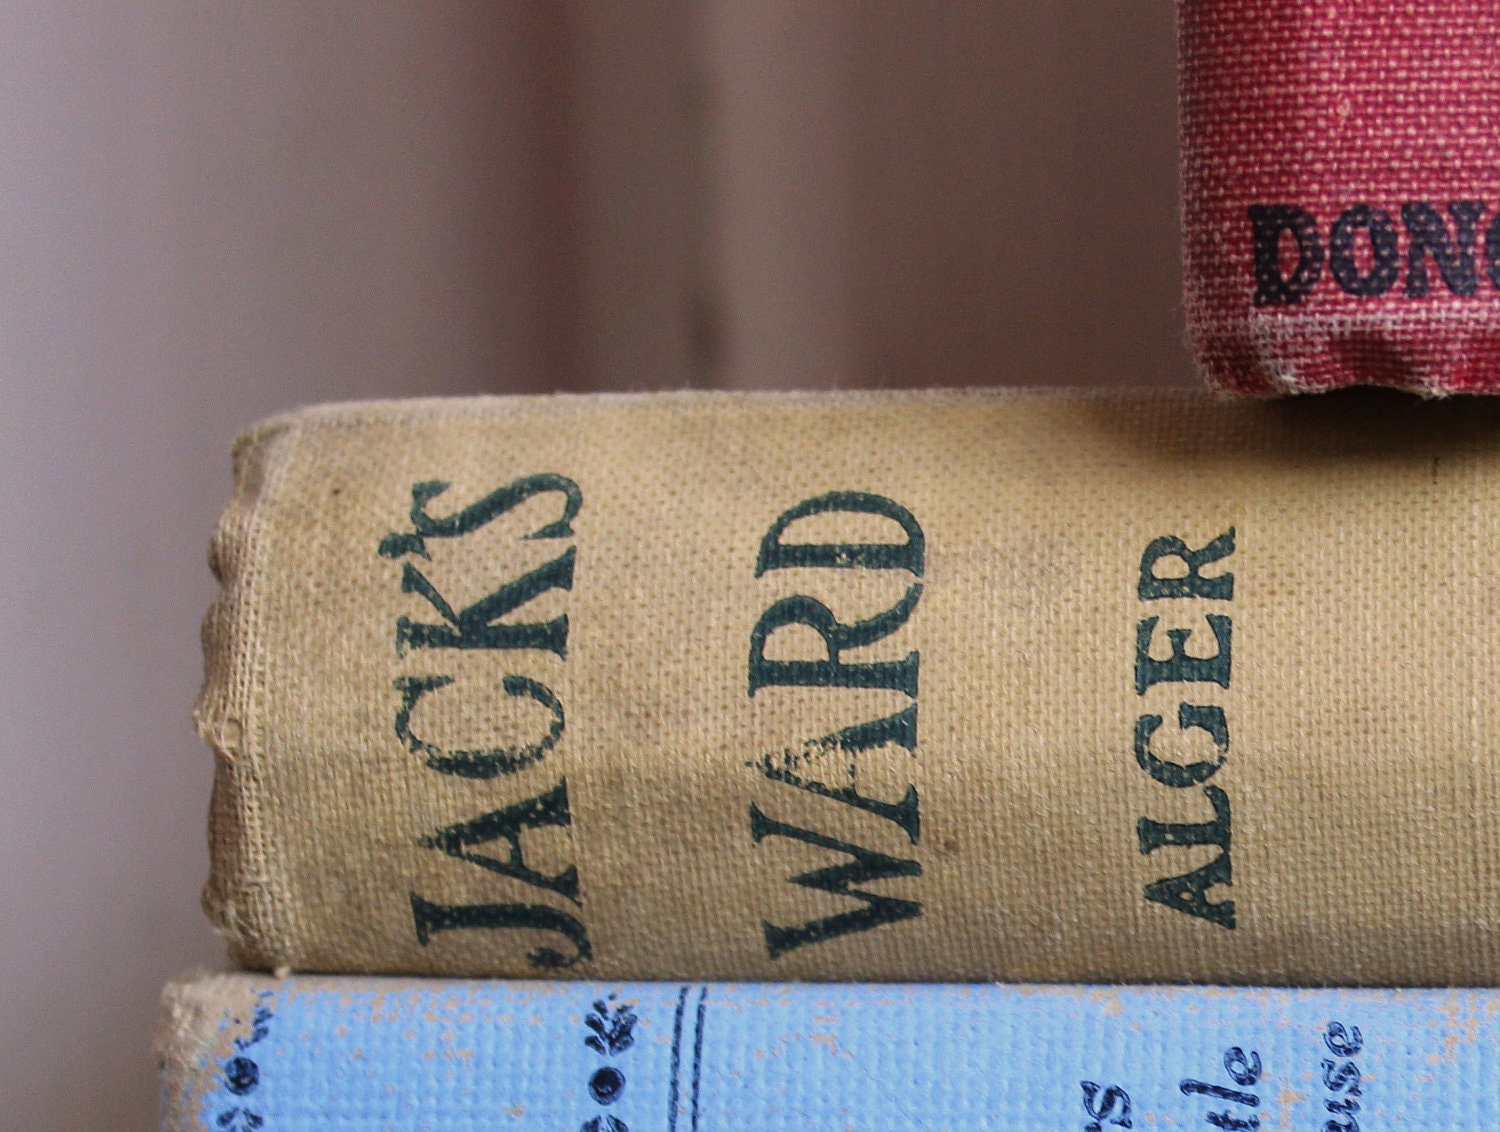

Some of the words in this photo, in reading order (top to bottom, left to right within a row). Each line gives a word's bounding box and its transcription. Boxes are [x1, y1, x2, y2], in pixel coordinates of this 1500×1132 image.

[378, 472, 592, 967] JACK'S
[747, 490, 926, 960] WARD
[1133, 526, 1237, 930] ALGER
